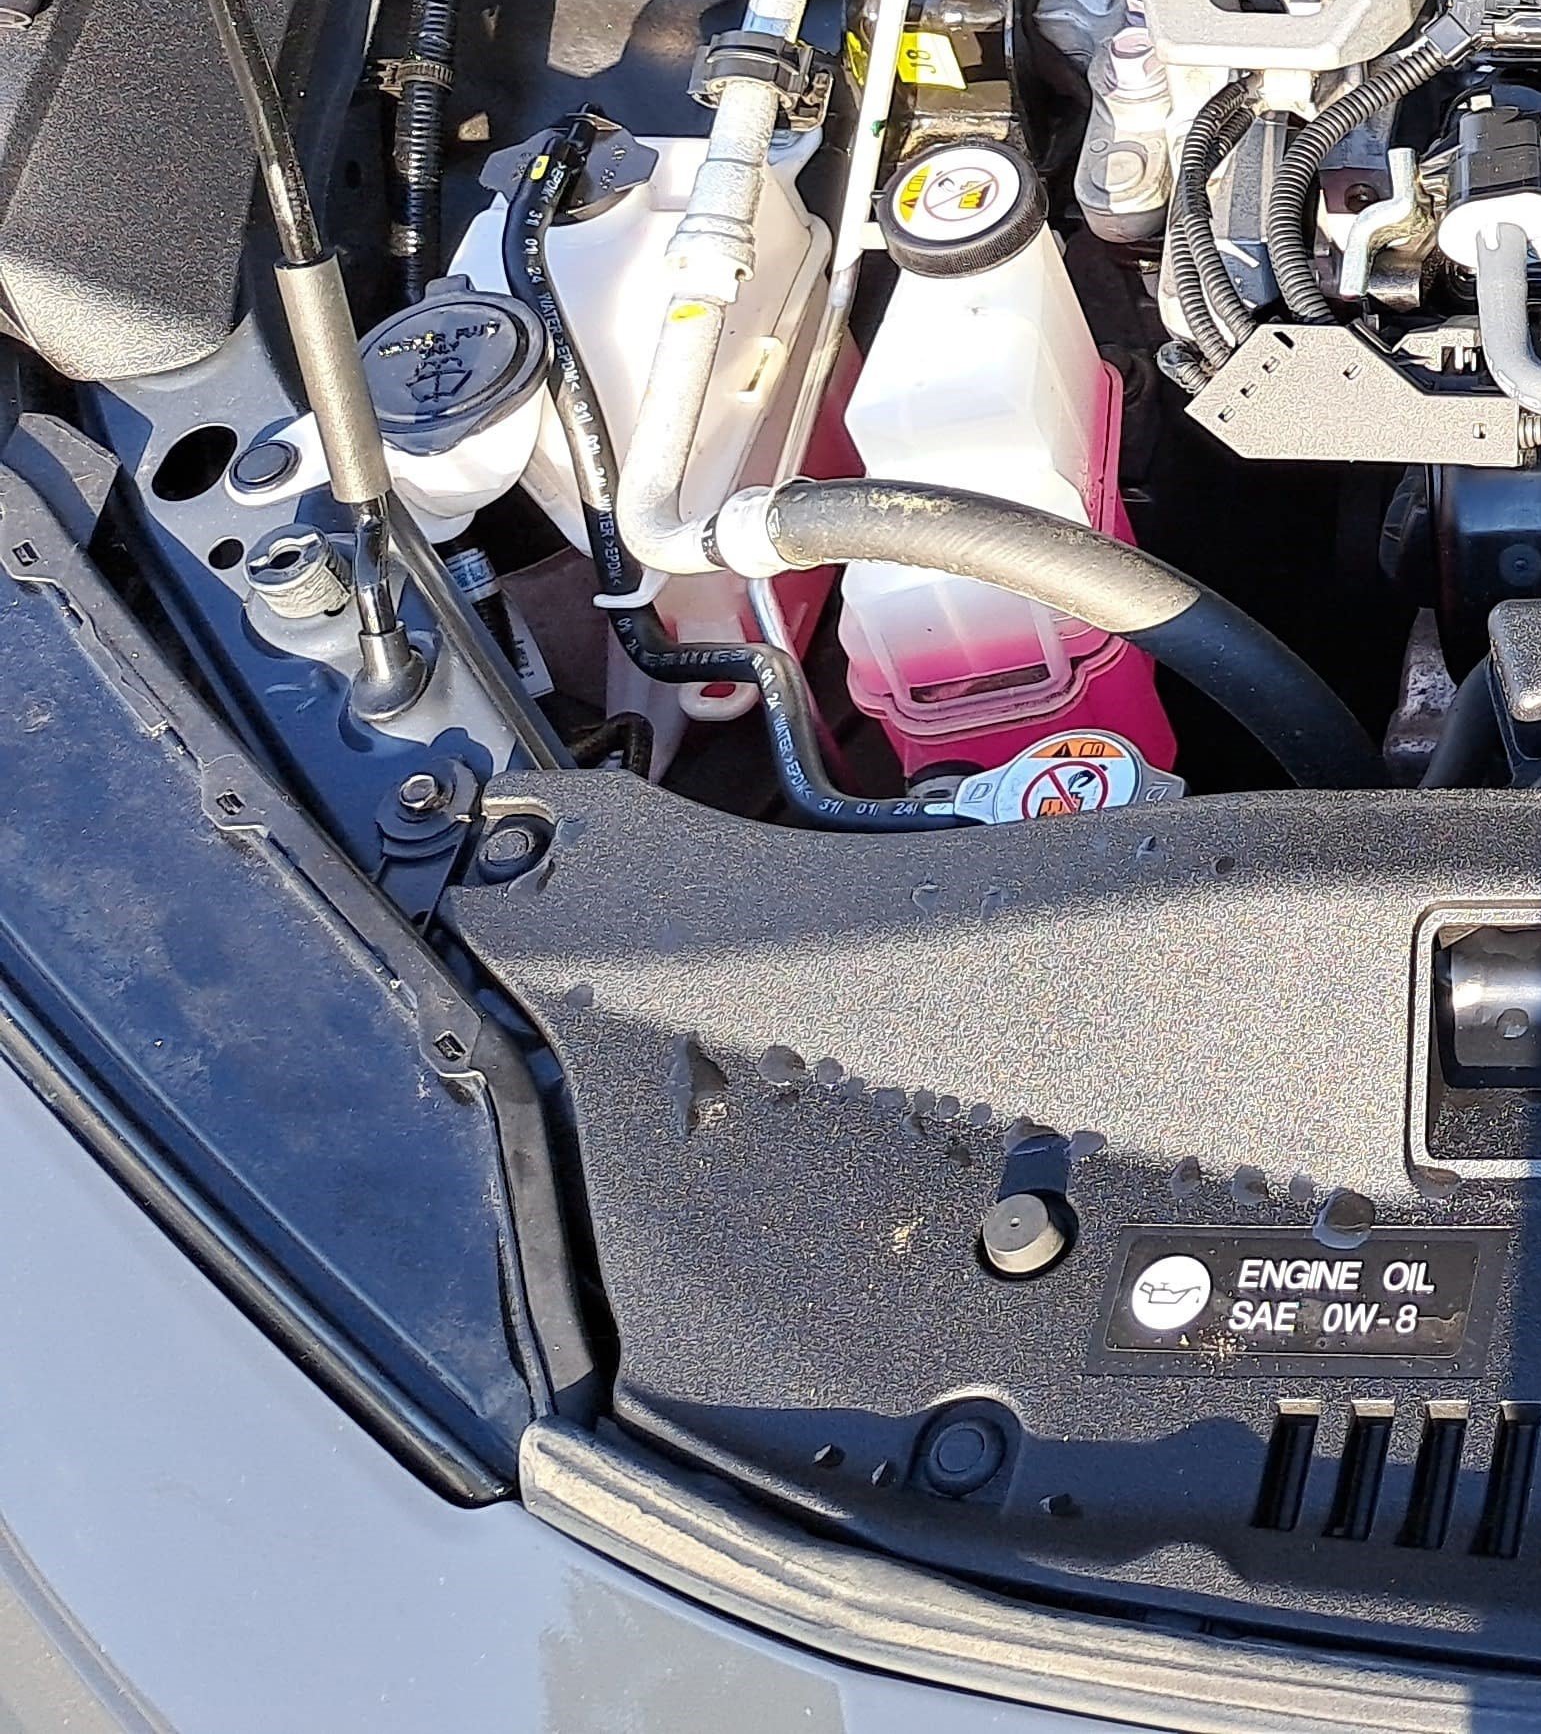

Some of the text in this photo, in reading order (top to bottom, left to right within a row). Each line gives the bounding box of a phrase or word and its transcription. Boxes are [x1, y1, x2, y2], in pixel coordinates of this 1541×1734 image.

[1236, 1258, 1436, 1294] ENGINE OIL
[1228, 1299, 1419, 1335] SAE 0W-8
